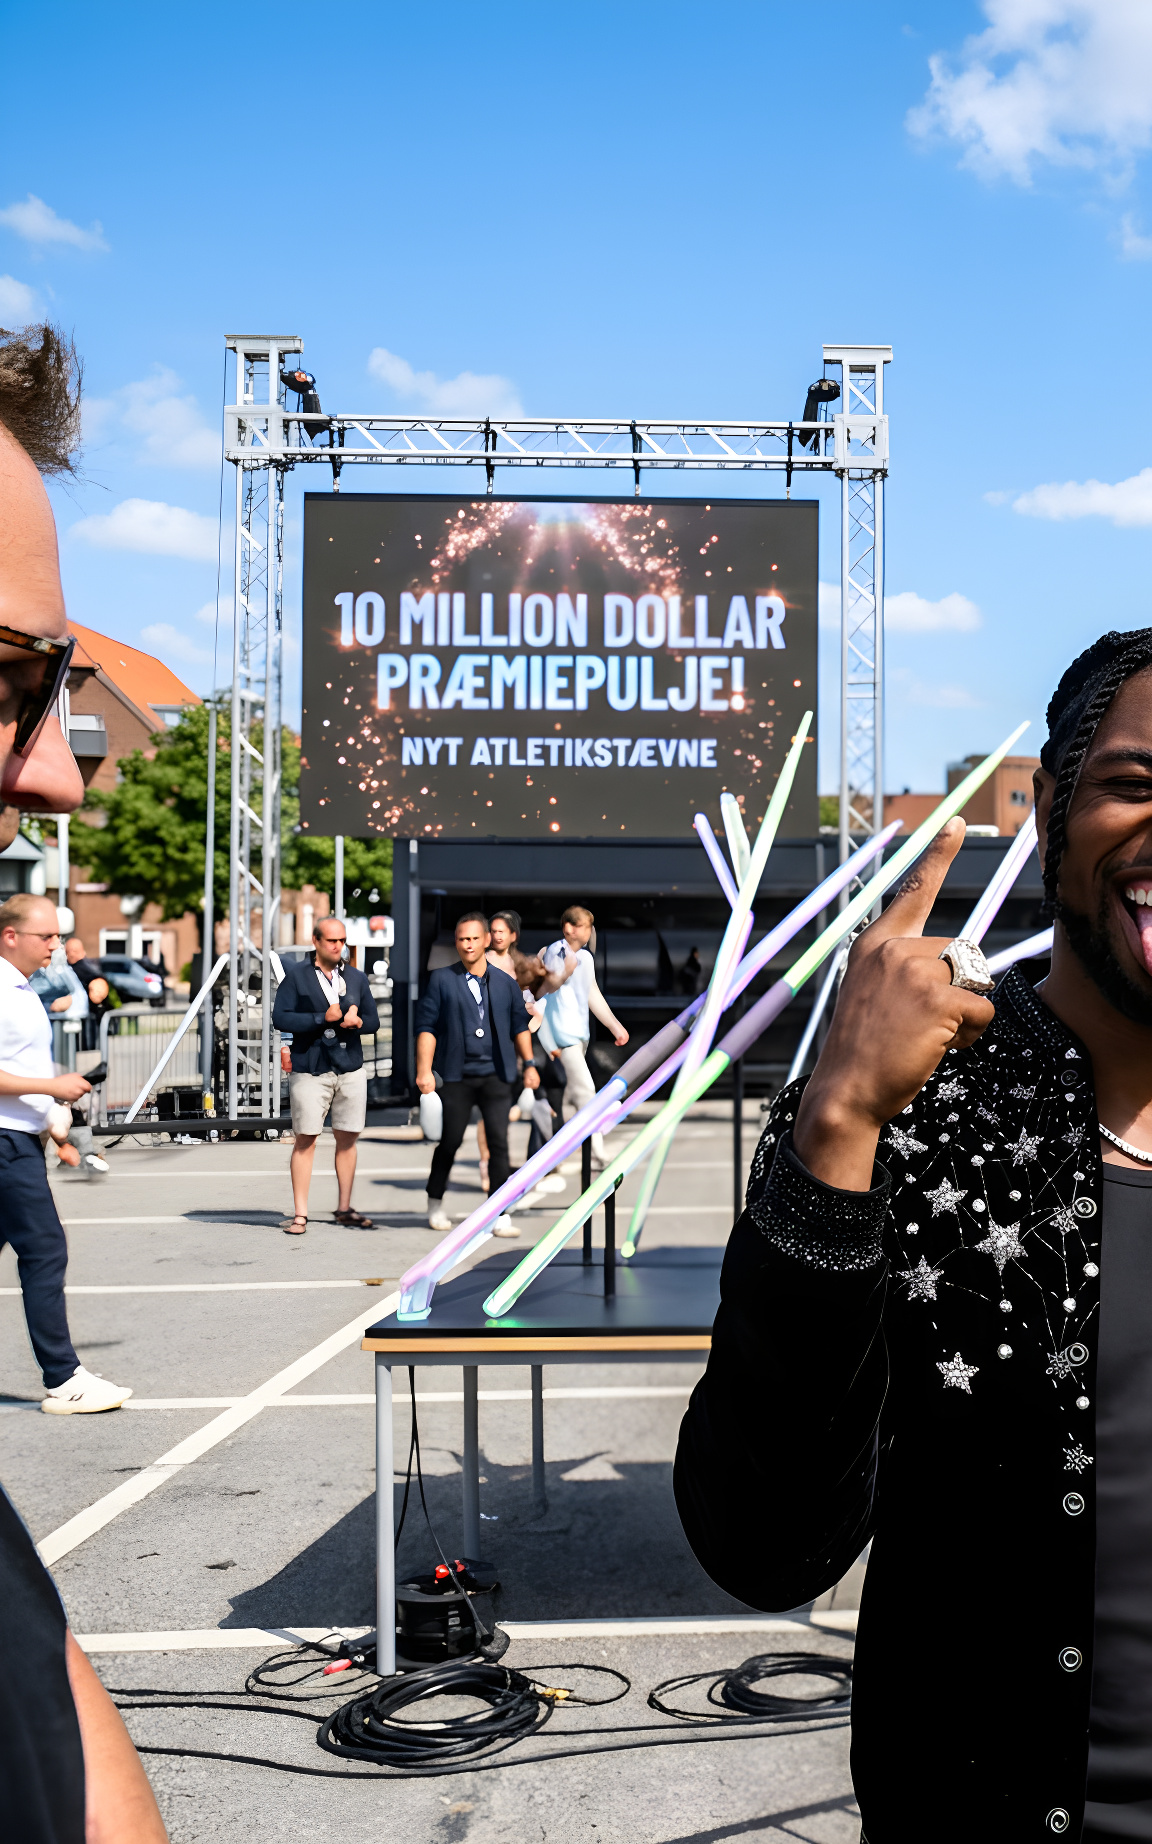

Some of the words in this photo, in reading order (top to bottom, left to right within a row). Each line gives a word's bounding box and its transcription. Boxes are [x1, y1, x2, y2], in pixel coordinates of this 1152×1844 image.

[334, 591, 386, 647] 10
[400, 592, 588, 648] MILLION
[603, 594, 786, 649] DOLLAR
[376, 653, 745, 711] PRÆMIEPULJE!
[401, 737, 463, 766] NYT
[470, 738, 718, 768] ATLETIKSTÆVNE
